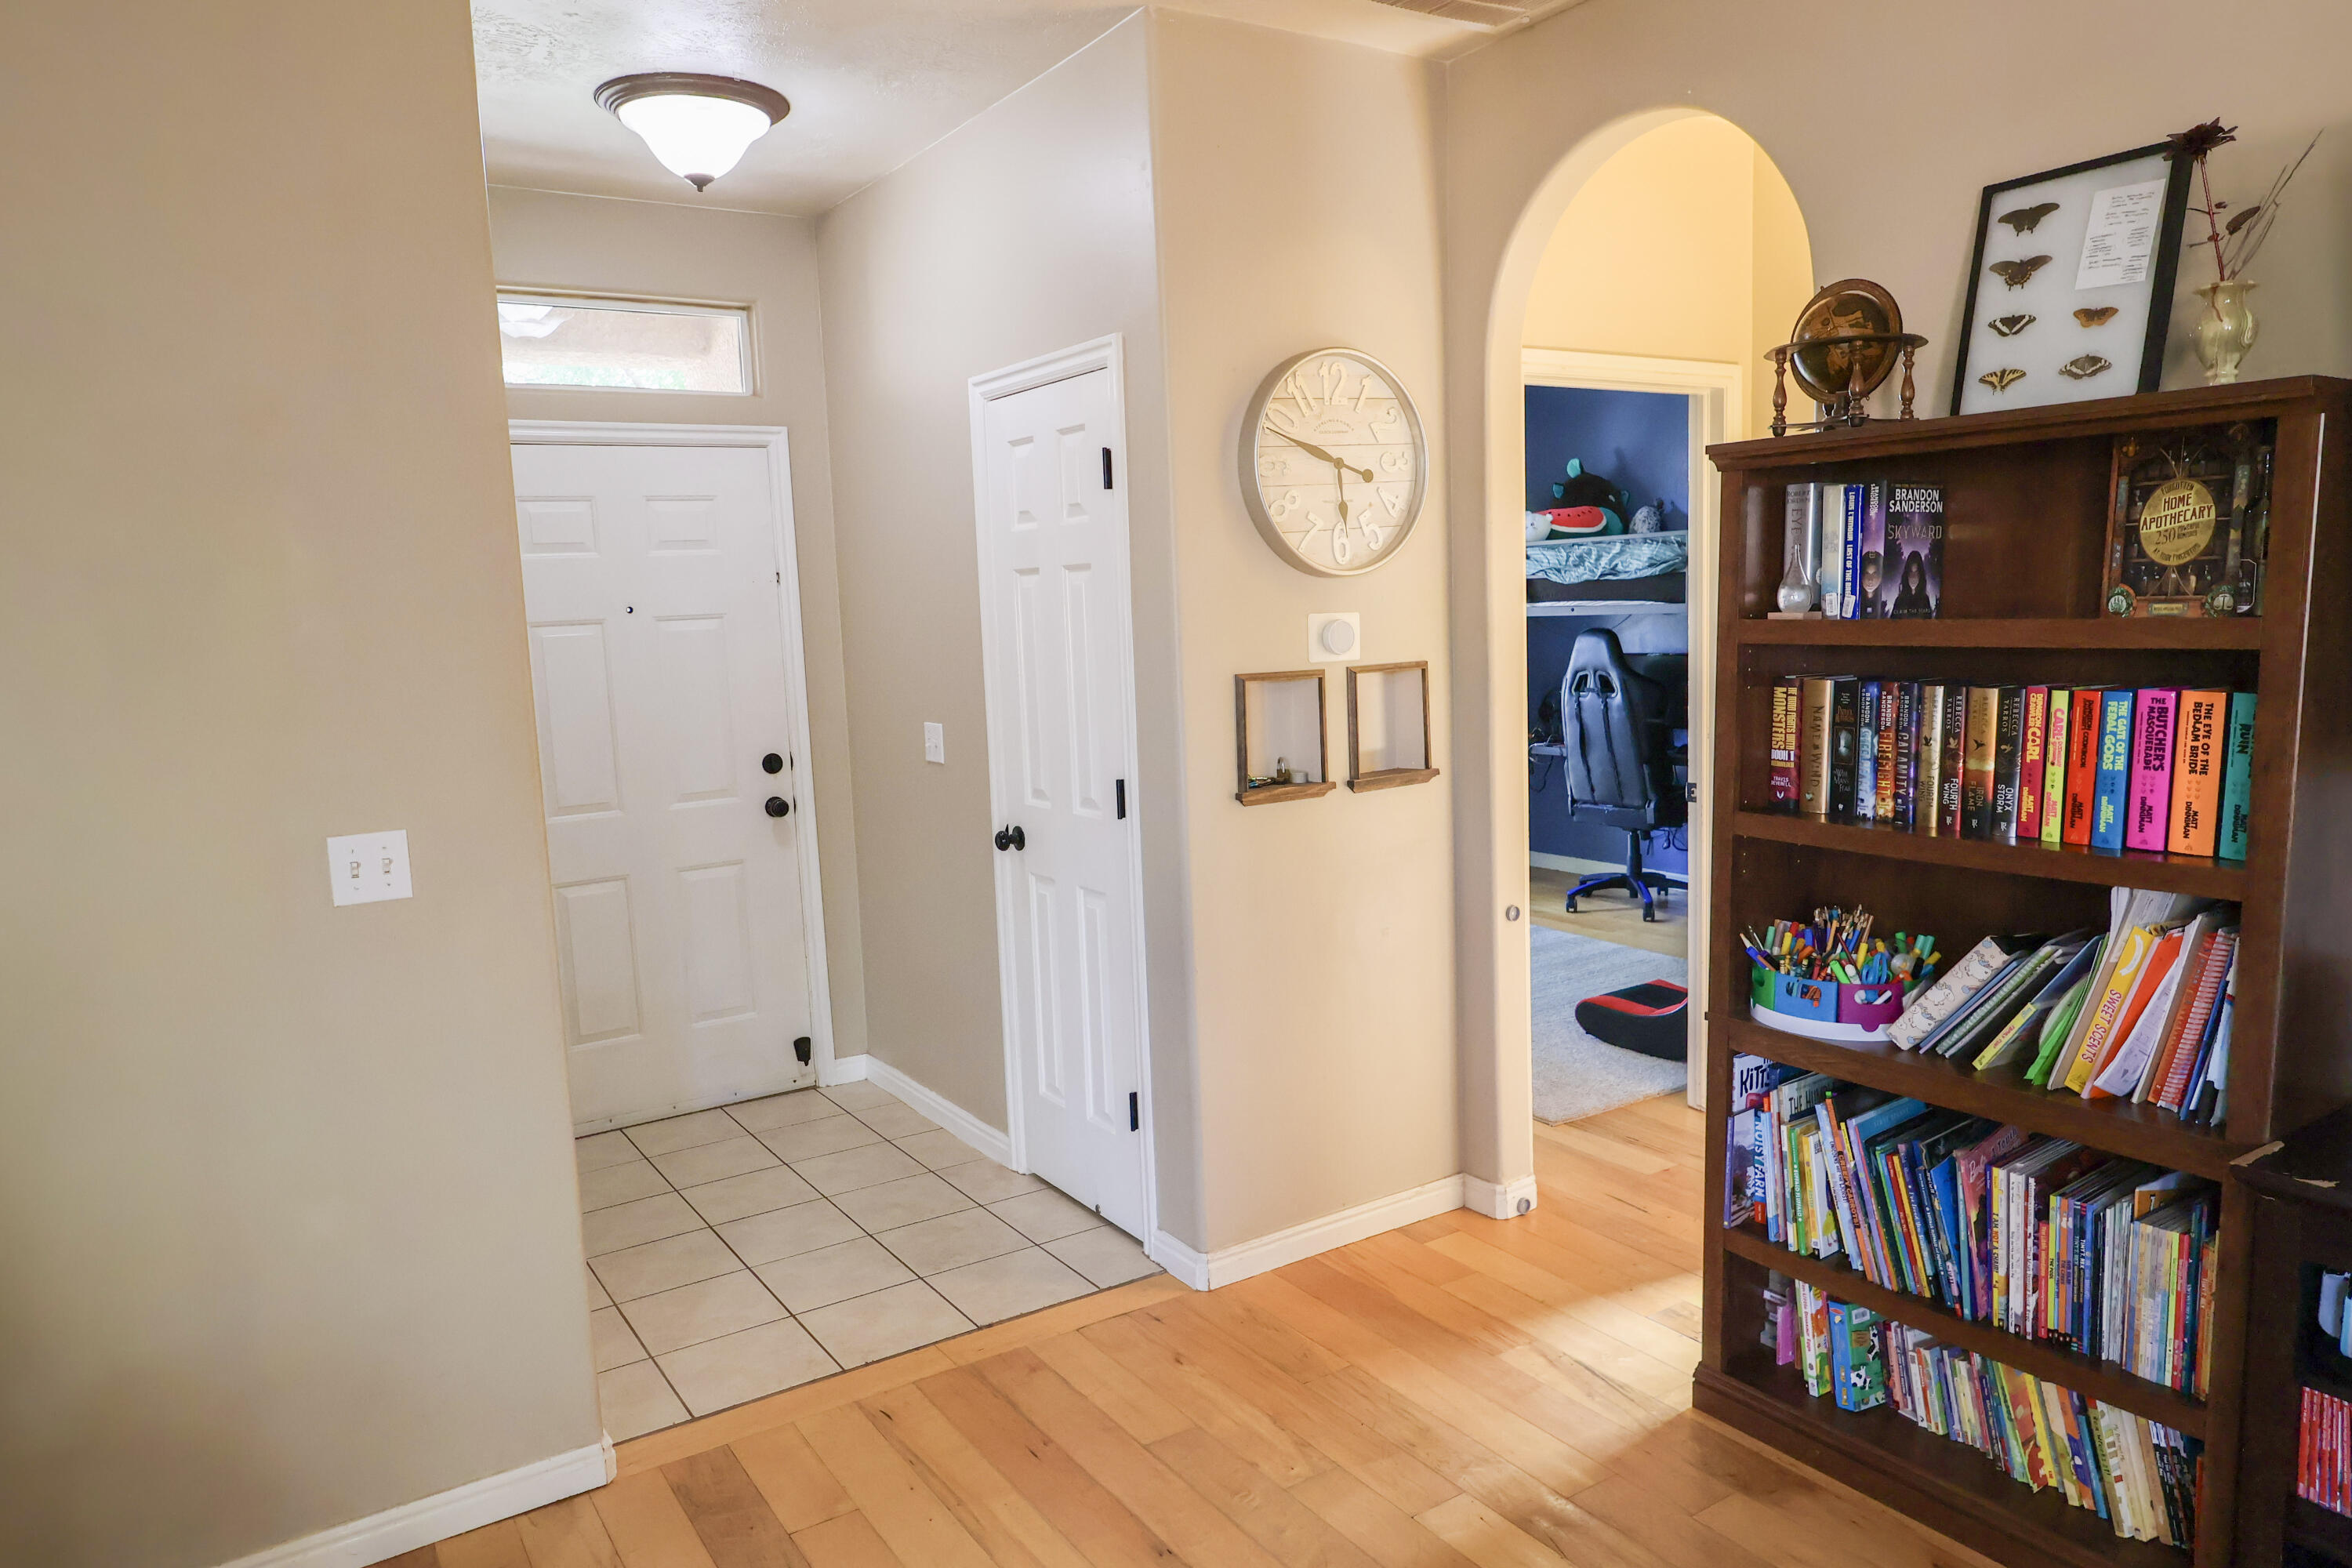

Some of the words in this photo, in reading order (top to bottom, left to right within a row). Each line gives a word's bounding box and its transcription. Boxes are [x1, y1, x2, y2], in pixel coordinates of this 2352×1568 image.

[1287, 371, 1317, 417] 11
[1319, 361, 1348, 405] 12
[1355, 375, 1372, 413] 1
[1370, 407, 1397, 443] 2
[1259, 455, 1290, 477] 9
[1380, 452, 1408, 473] 3
[1377, 486, 1404, 518] 4
[1895, 488, 1940, 501] BRANDON
[2161, 481, 2194, 495] FORGOTTEN
[2163, 492, 2192, 512] HOME
[1269, 489, 1301, 522] 8
[1791, 509, 1802, 533] EYE
[1889, 500, 1943, 513] SANDERSON
[2141, 505, 2213, 531] APOTHECARY
[1298, 511, 1323, 552] 7
[1333, 521, 1350, 564] 6
[1358, 509, 1383, 551] 5
[1888, 523, 1942, 539] SKYWARD
[2155, 528, 2176, 545] 250
[1846, 560, 1853, 568] OF
[1772, 687, 1787, 750] MONSTERS
[1787, 712, 1796, 733] FIGHTS
[1810, 706, 1825, 740] NAME
[1980, 696, 1989, 735] REBECCA
[2001, 699, 2009, 732] YARROS
[2011, 696, 2020, 736] REBECCA
[2106, 701, 2118, 734] FERAL
[2118, 700, 2129, 717] THE
[2191, 702, 2203, 742] BEDLAM
[2204, 702, 2214, 720] THE
[1786, 734, 1795, 750] WITH
[2117, 719, 2127, 739] GATE
[2143, 706, 2156, 771] MASQUERADE
[2152, 706, 2169, 771] BUTCHER'S
[2202, 723, 2212, 739] EYE
[2236, 723, 2252, 755] RUIN
[1771, 750, 1788, 760] BOOK
[1790, 750, 1795, 760] 1
[2027, 727, 2042, 764] CARL
[2103, 734, 2115, 771] GODS
[2115, 741, 2125, 753] OF
[2189, 746, 2199, 775] BRIDE
[2201, 742, 2210, 757] OF
[1810, 753, 1821, 787] WIND
[1877, 732, 1893, 796] FIREFIGHT
[1896, 732, 1909, 795] CALAMITY
[2114, 754, 2125, 771] THE
[2199, 758, 2209, 776] THE
[1926, 775, 1935, 808] FOURTH
[1949, 778, 1958, 811] FOURTH
[1967, 781, 1976, 811] FLAME
[1996, 784, 2005, 813] STORM
[2003, 787, 2014, 812] ONYX
[2070, 793, 2078, 829] DINNIMAN
[2075, 801, 2084, 820] MATT
[2100, 796, 2108, 833] DINNIMAN
[2106, 804, 2114, 823] MATT
[2138, 796, 2147, 833] DINNIMAN
[2145, 805, 2154, 824] MATT
[2183, 801, 2193, 839] DINNIMAN
[2190, 810, 2199, 830] MATT
[2231, 804, 2241, 844] DINNIMAN
[2100, 989, 2123, 1025] SWEET
[2081, 1023, 2107, 1064] SCENTS
[1788, 1094, 1802, 1114] THE
[1755, 1121, 1765, 1161] NOISY
[1755, 1164, 1766, 1196] FARM
[1838, 1153, 1851, 1187] CREEPY
[1847, 1187, 1860, 1229] CARROTS!
[1994, 1218, 1999, 1228] AM
